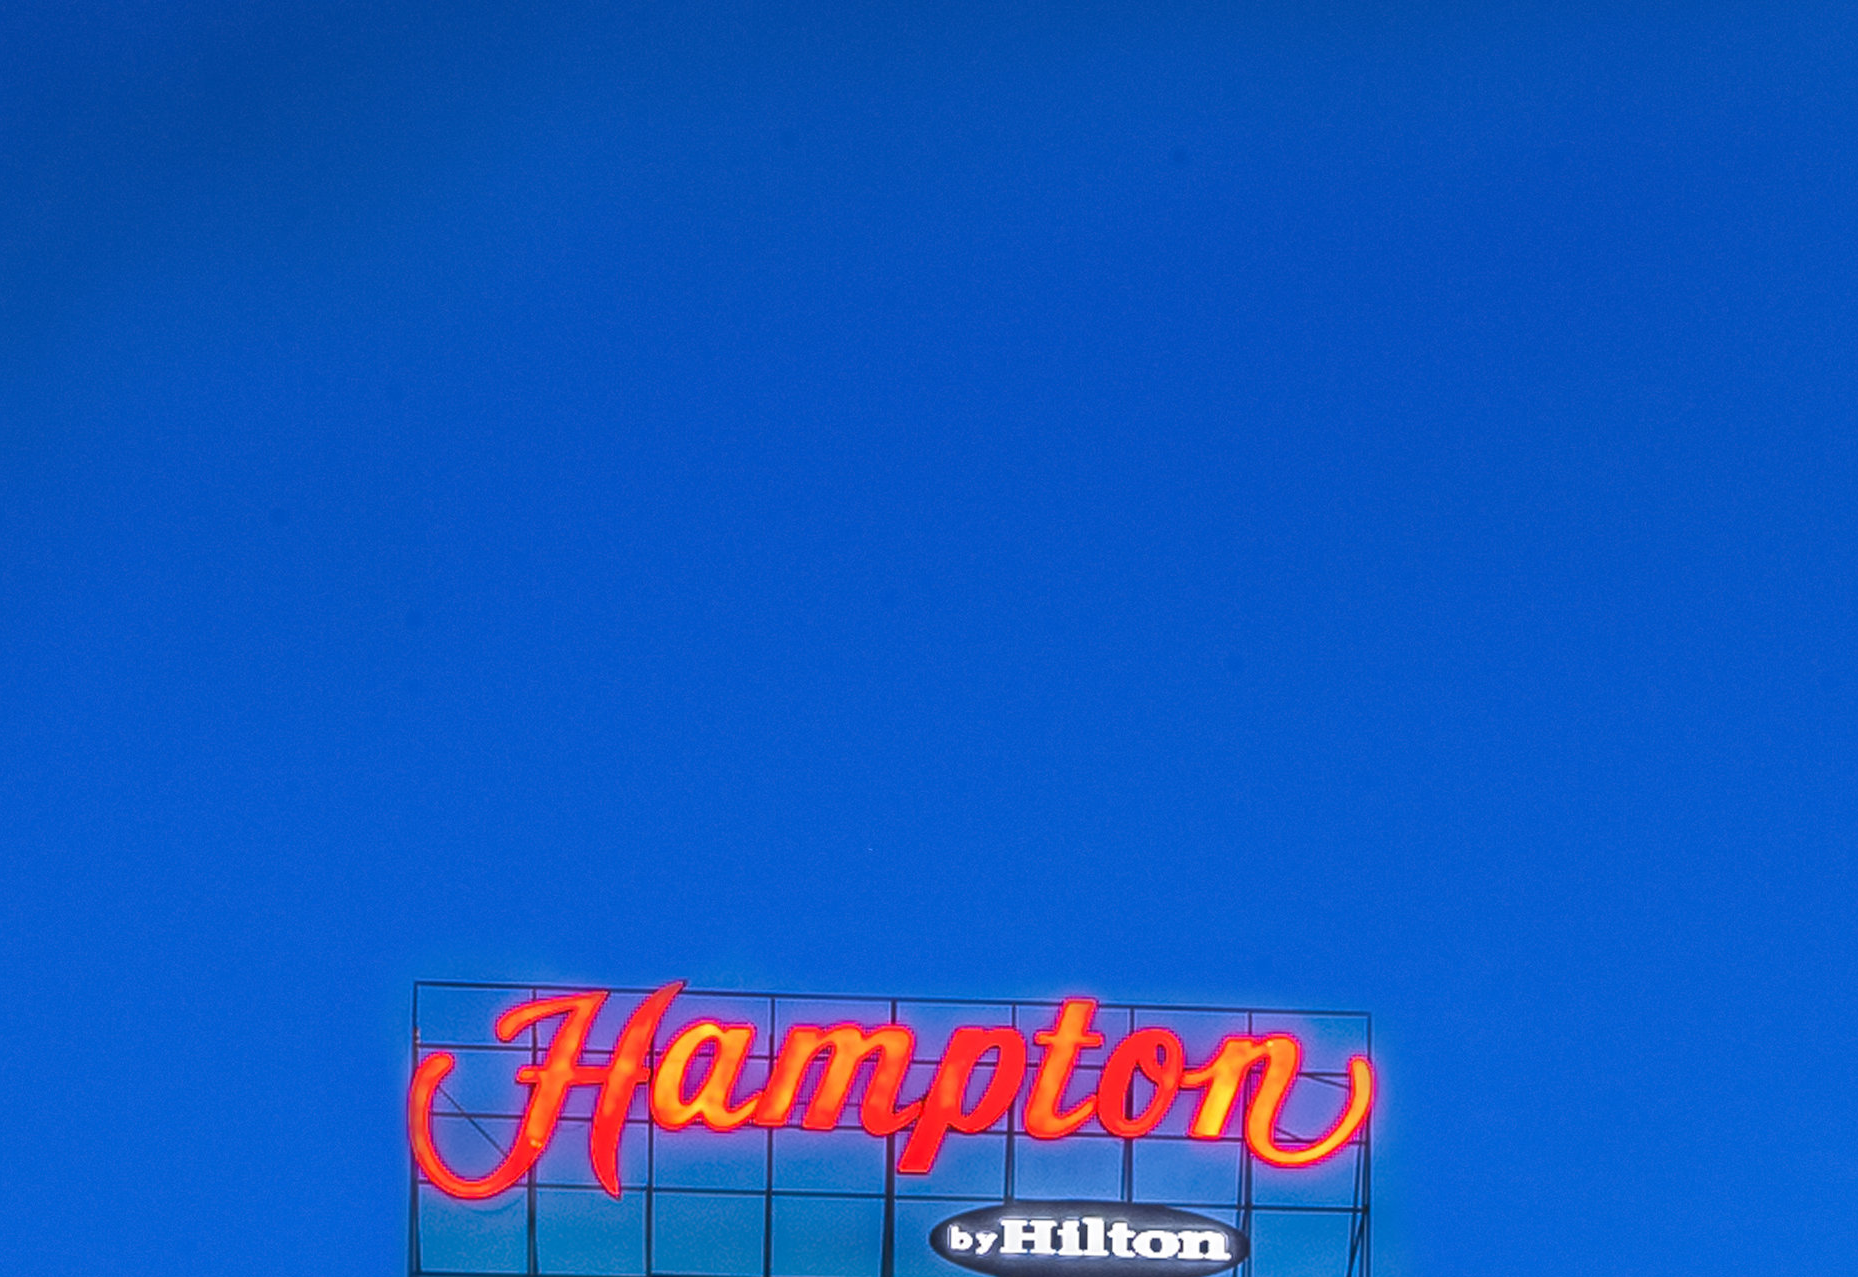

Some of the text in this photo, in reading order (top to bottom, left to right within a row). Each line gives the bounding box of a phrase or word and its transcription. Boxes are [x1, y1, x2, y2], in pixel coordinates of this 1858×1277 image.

[410, 981, 1373, 1200] Hampton
[948, 1216, 1232, 1261] by Hilton
